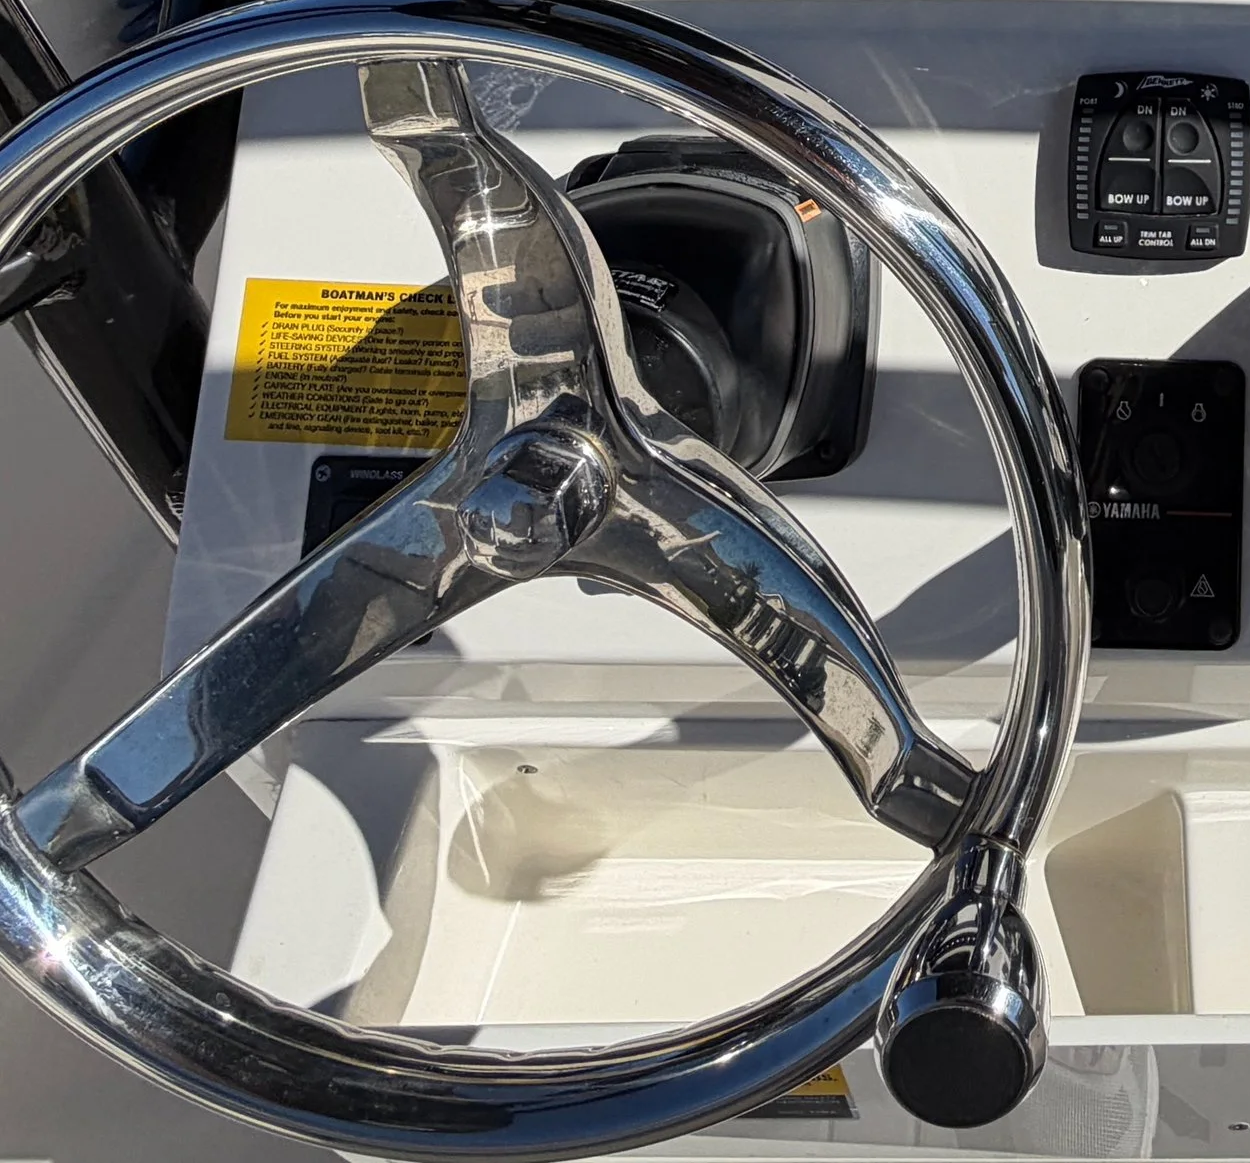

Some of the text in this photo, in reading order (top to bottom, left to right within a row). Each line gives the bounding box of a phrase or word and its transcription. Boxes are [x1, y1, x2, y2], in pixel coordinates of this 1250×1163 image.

[1137, 105, 1153, 115] DN
[1170, 106, 1187, 116] DN
[1107, 194, 1150, 204] BOW UP
[1166, 195, 1209, 206] BOW UP
[1113, 236, 1124, 244] UP
[1140, 231, 1172, 239] TRIM TAB
[1138, 238, 1174, 247] CONTROL
[1190, 238, 1216, 246] ALL DN
[321, 288, 395, 302] BOATMAN'S
[400, 292, 444, 305] CHECK
[275, 301, 289, 309] For
[290, 303, 330, 311] maximum
[332, 304, 374, 314] enjoyment
[376, 306, 391, 314] and
[421, 308, 445, 316] check
[274, 311, 302, 319] Before
[272, 322, 299, 331] DRAIN
[301, 323, 325, 332] PLUG
[271, 332, 324, 342] LIFE-SAVING
[326, 334, 364, 344] DEVICES
[399, 338, 420, 347] every
[422, 339, 450, 348] person
[270, 341, 313, 352] STEERING
[315, 343, 352, 353] SYSTEM
[427, 349, 443, 357] and
[268, 351, 289, 360] FUEL
[292, 352, 328, 362] SYSTEM
[267, 361, 306, 371] BATTERY
[265, 371, 299, 380] ENGINE
[264, 381, 308, 391] CAPACITY
[308, 383, 335, 392] PLATE
[262, 391, 305, 401] WEATHER
[306, 393, 361, 404] CONDITIONS
[261, 401, 313, 412] ELECTRICAL
[315, 403, 367, 414] EQUIPMENT
[260, 411, 317, 422] EMERGENCY
[317, 413, 342, 423] GEAR
[1102, 503, 1161, 520] YAMAHA
